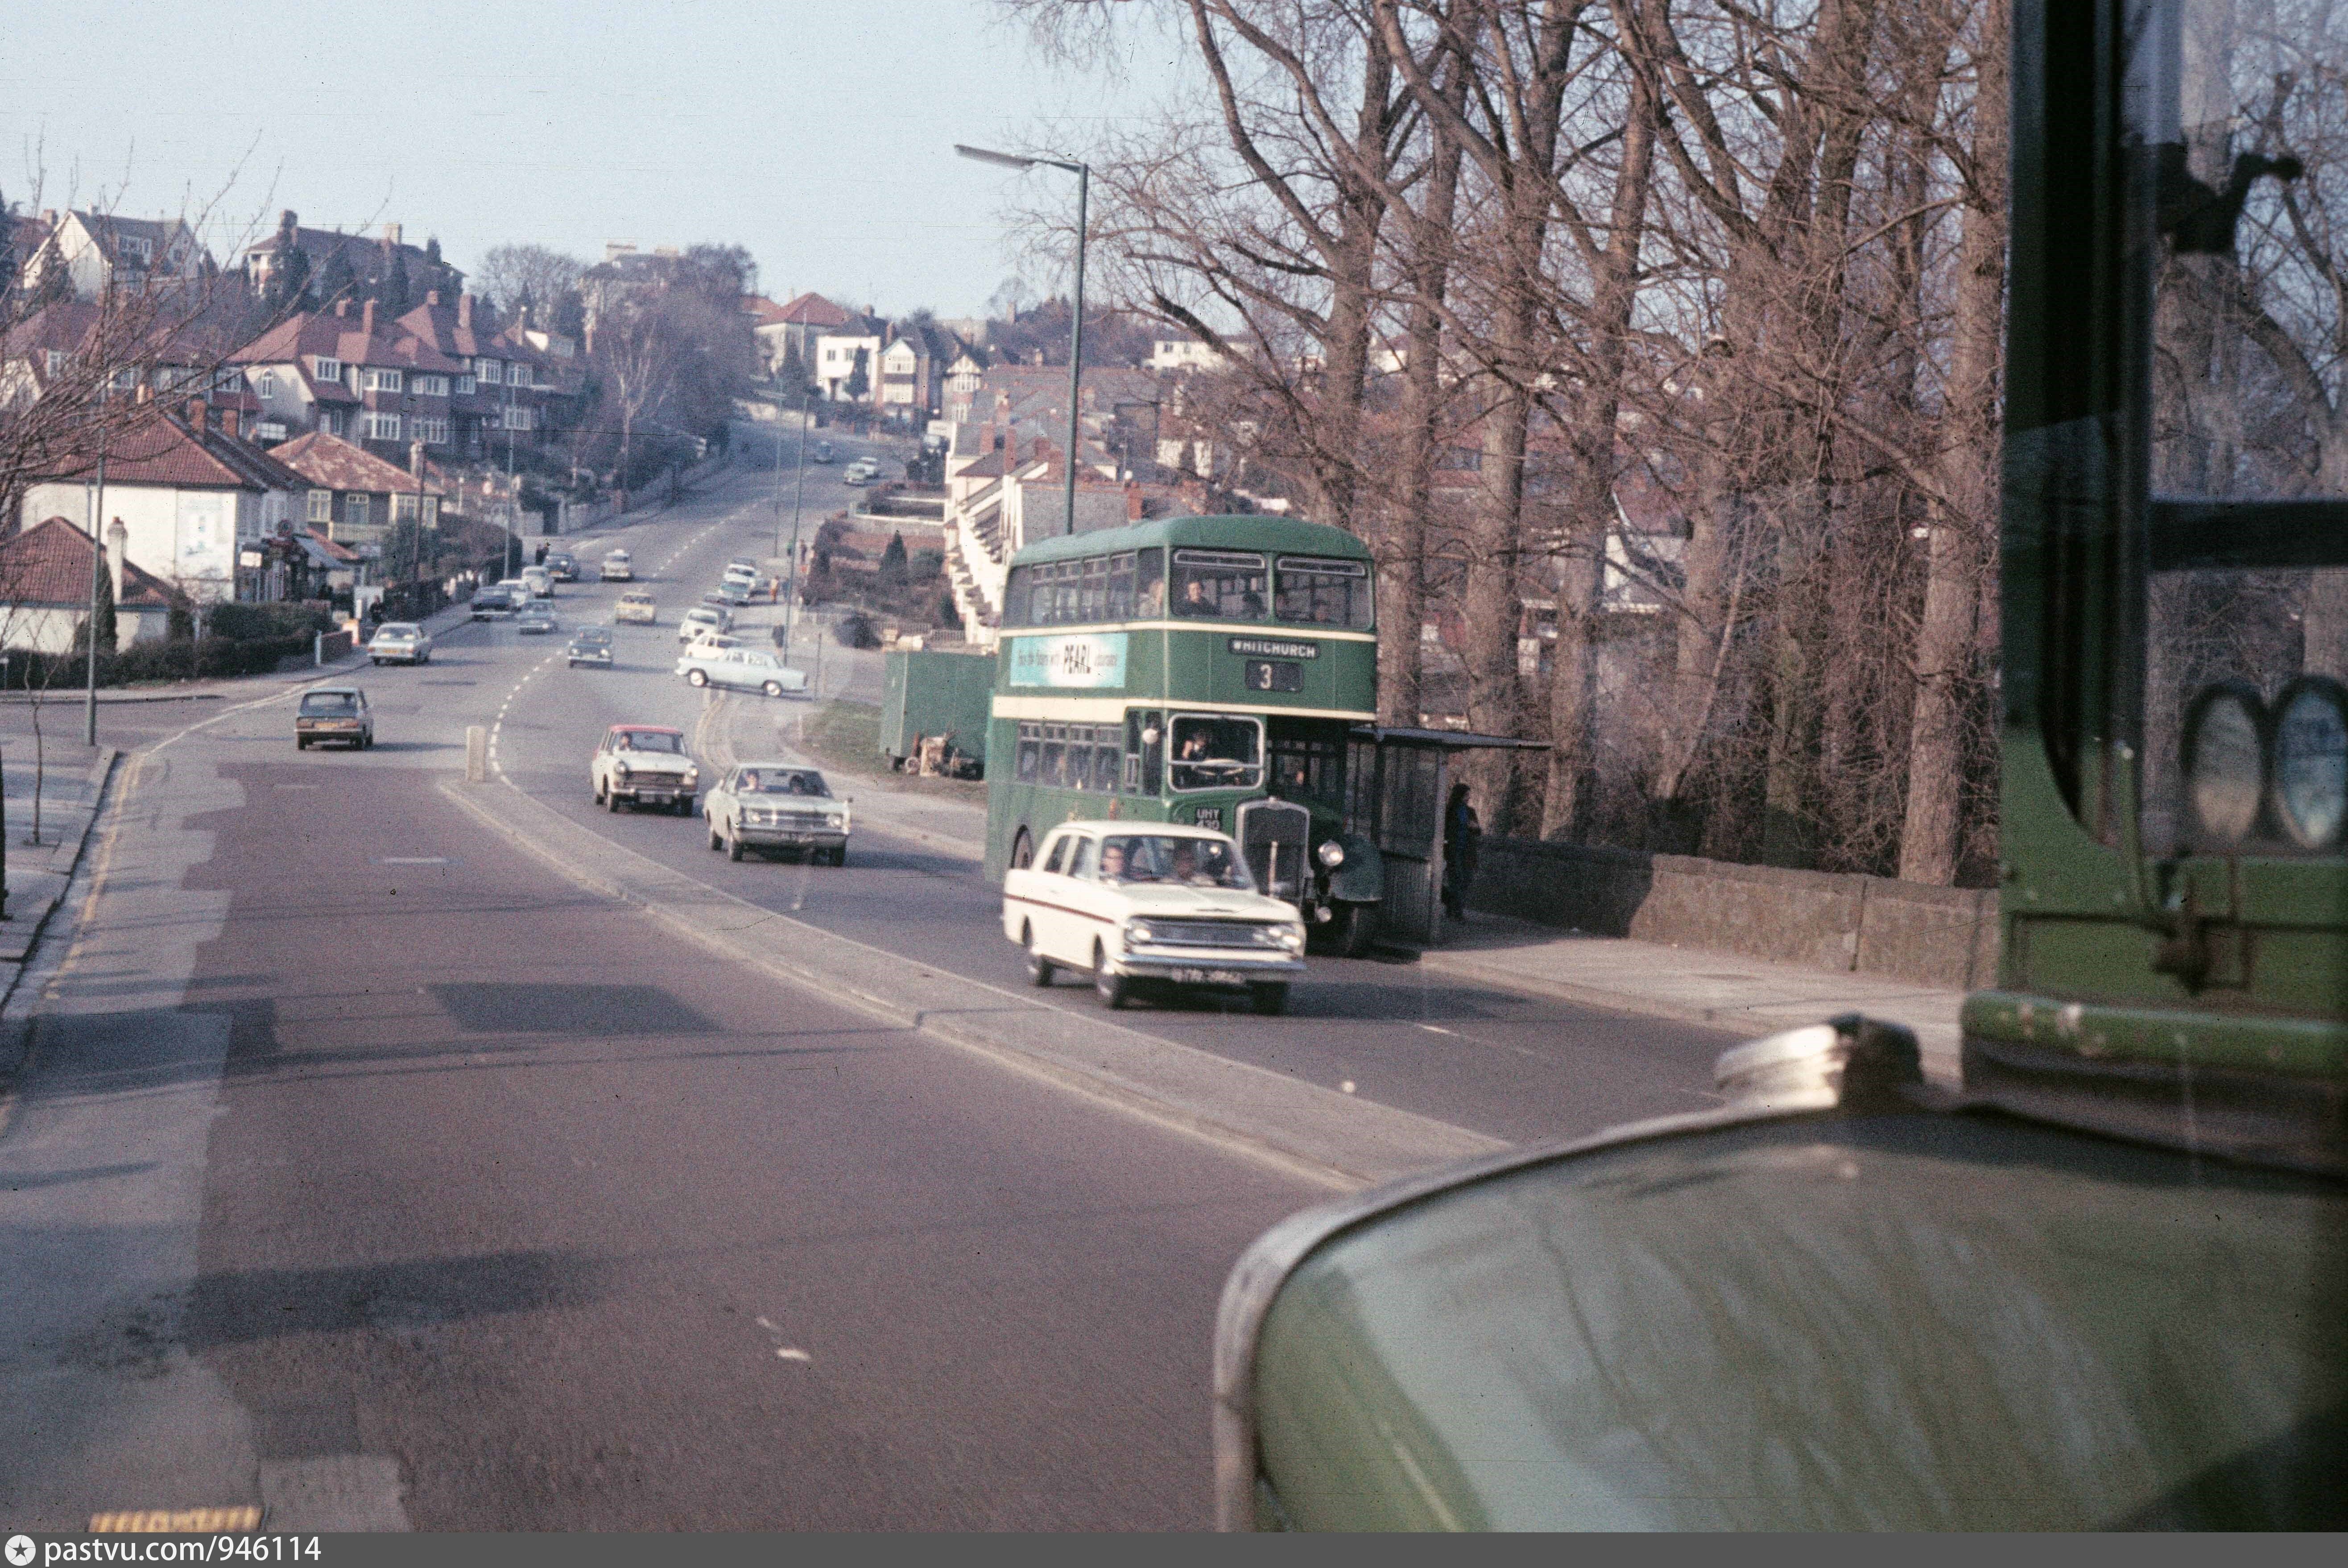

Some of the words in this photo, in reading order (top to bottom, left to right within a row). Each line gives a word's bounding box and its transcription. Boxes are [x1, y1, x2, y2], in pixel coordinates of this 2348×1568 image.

[1063, 644, 1091, 674] PEARL
[1260, 663, 1272, 690] 3
[1196, 808, 1220, 820] UHY
